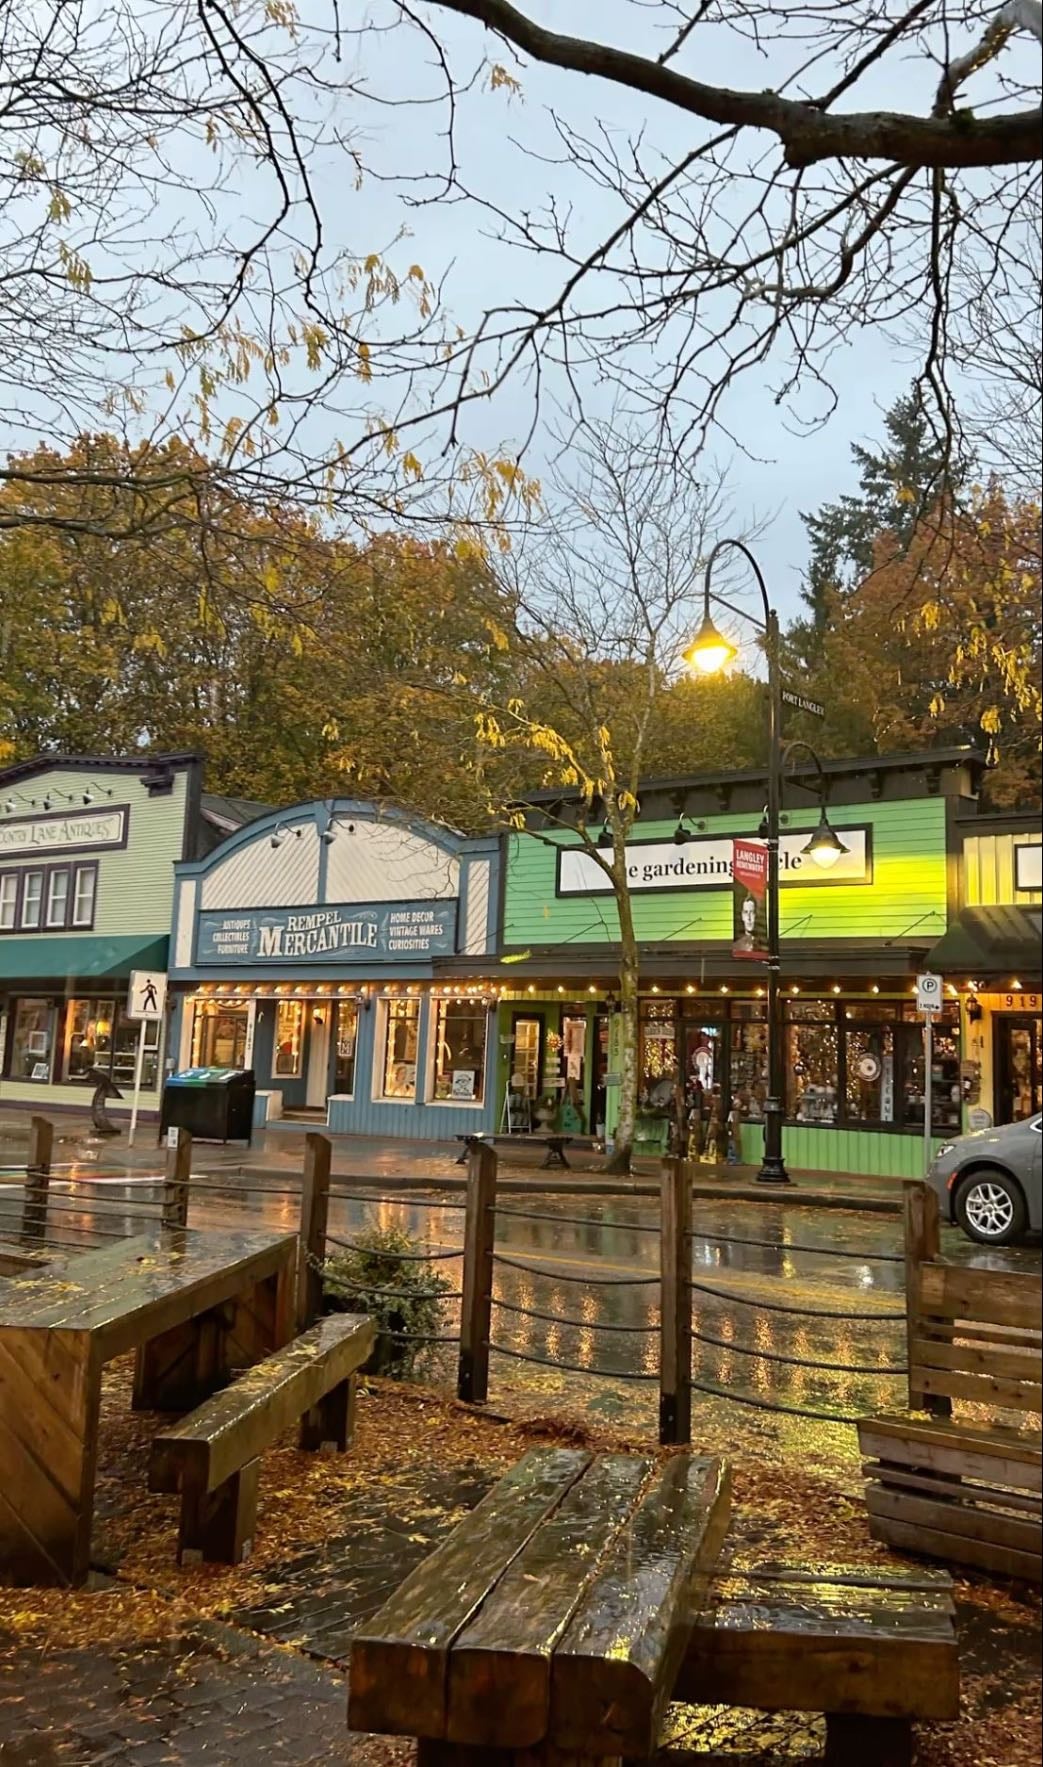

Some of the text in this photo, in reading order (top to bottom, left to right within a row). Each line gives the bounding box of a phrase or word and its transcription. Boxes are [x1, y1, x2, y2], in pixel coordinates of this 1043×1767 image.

[736, 849, 765, 865] LANGLEY
[286, 909, 342, 932] REMPEL
[390, 911, 434, 923] HOME DECOR
[222, 920, 252, 930] ANTIQUES
[389, 924, 444, 937] VINTAGE WARES
[212, 931, 250, 942] COLLECTIBLES
[256, 922, 378, 957] MERCANTILE
[388, 939, 430, 950] CURIOSITIES
